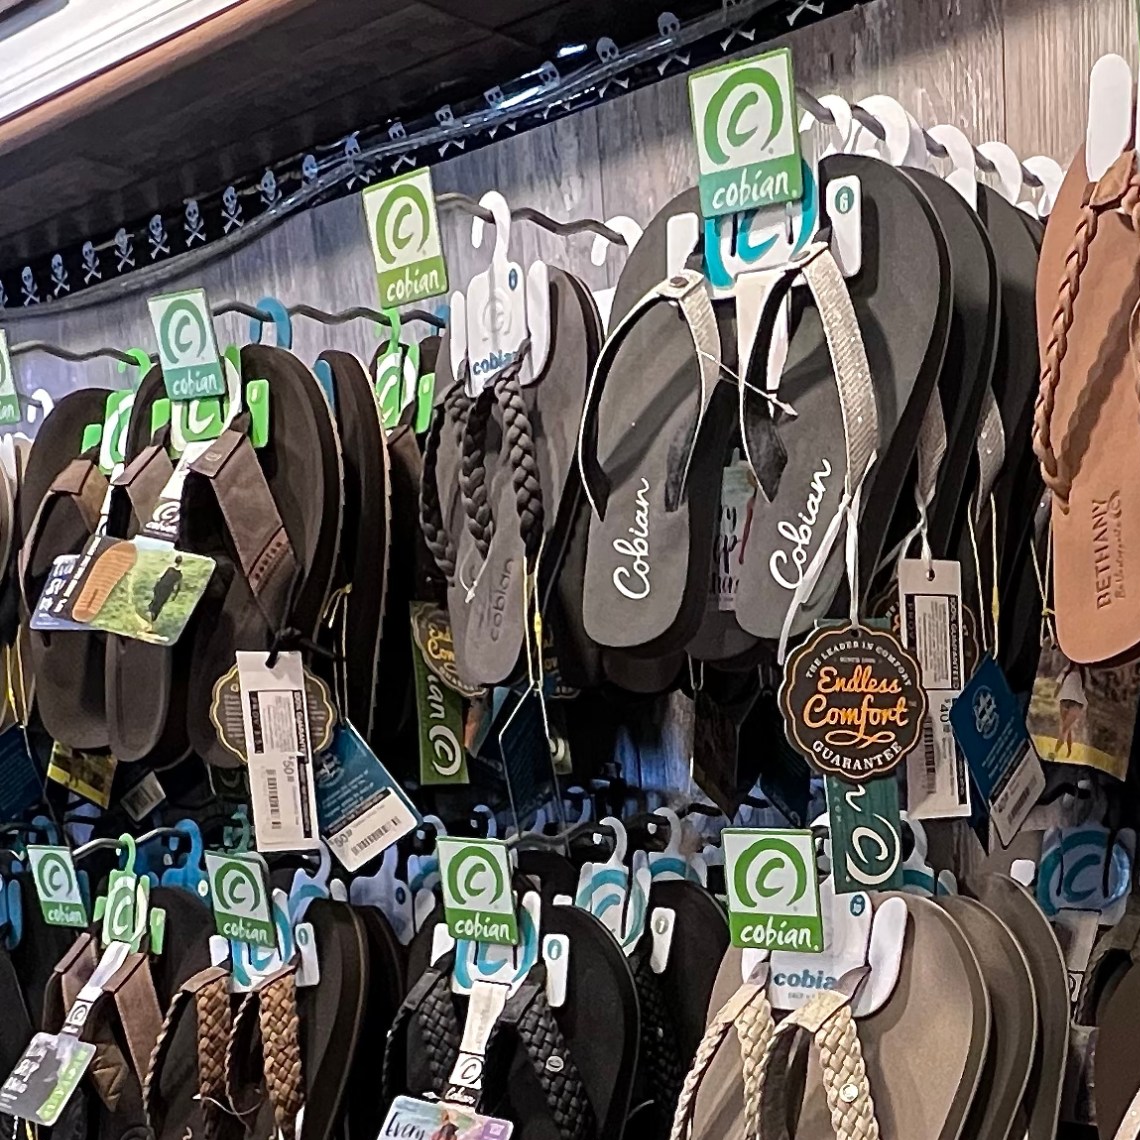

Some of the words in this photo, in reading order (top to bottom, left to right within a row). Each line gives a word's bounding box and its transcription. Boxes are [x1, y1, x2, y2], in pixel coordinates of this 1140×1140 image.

[712, 169, 792, 209] cobian
[386, 267, 441, 302] cobian
[172, 371, 219, 397] cobian
[613, 477, 651, 600] Cobian
[770, 458, 832, 589] Cobian
[1094, 499, 1112, 609] BETHANY
[491, 558, 514, 642] cobian
[806, 658, 821, 679] THE
[821, 641, 859, 660] LEADER
[862, 641, 875, 650] IN
[875, 646, 912, 686] COMFORT
[818, 665, 902, 693] Endless
[804, 694, 909, 740] Comfort
[812, 740, 902, 770] GUARANTEE
[222, 919, 269, 943] cobian
[454, 917, 510, 942] cobian
[740, 917, 811, 947] cobian
[773, 969, 838, 992] cobia
